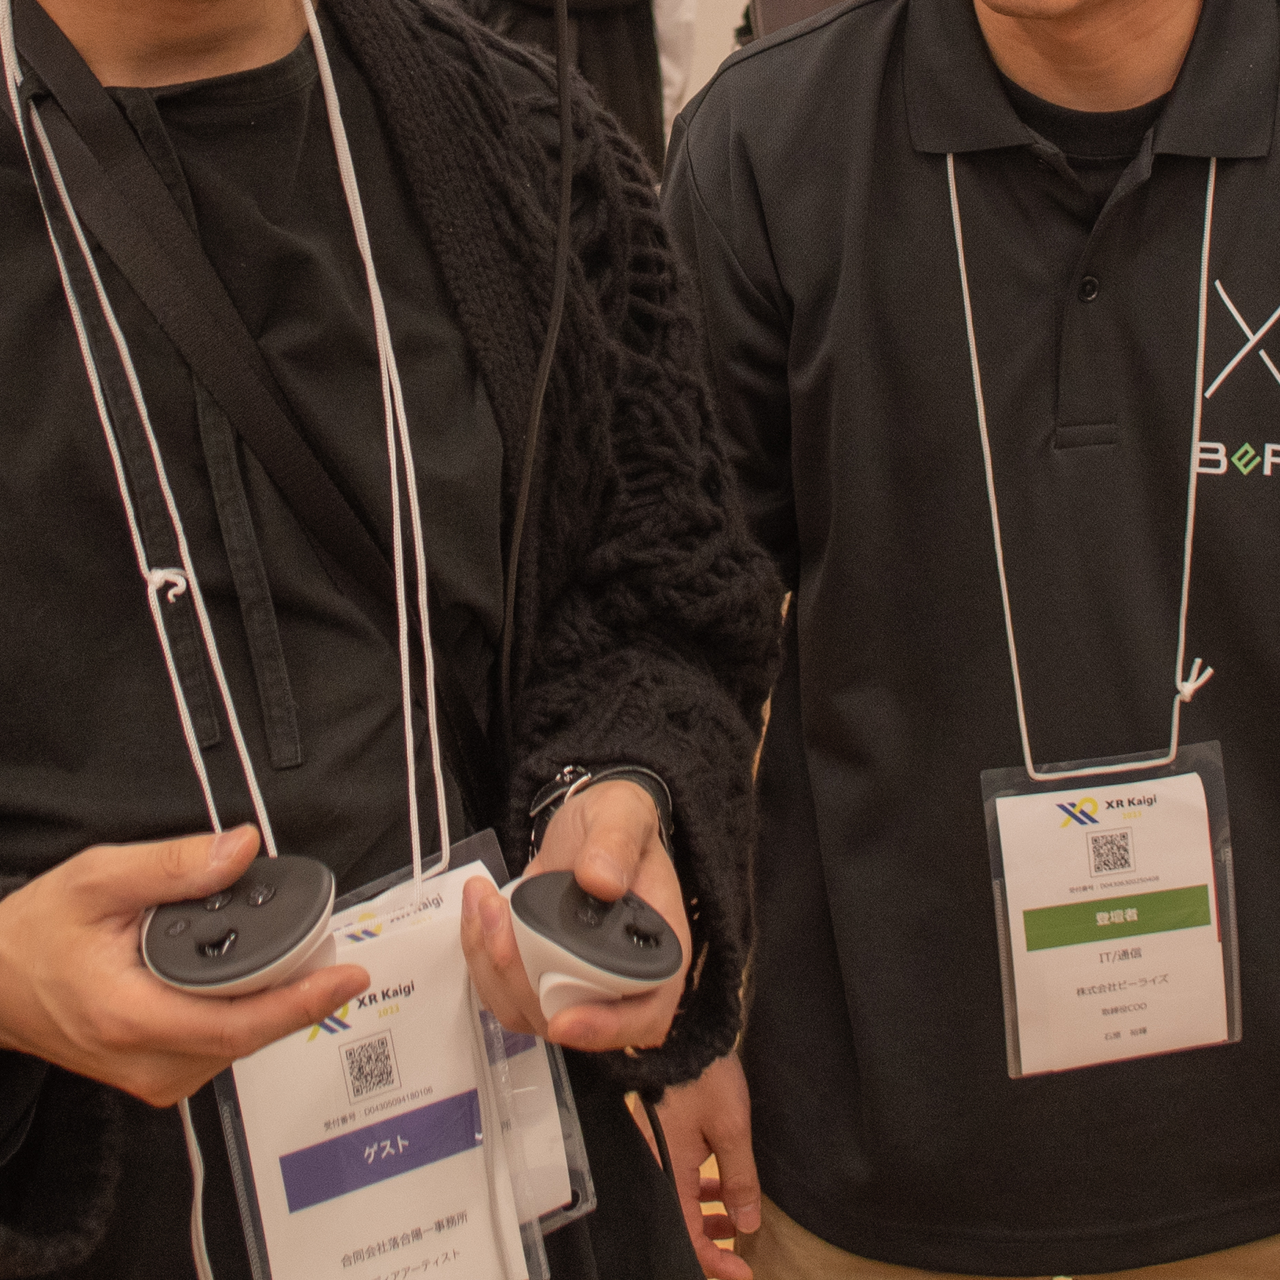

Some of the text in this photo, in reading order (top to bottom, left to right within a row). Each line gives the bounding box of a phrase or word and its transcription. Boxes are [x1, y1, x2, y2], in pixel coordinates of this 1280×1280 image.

[1105, 794, 1157, 810] XR Kaigi
[1099, 947, 1142, 964] IT/通信
[356, 979, 415, 1010] XR Kaigi
[377, 1003, 400, 1019] 2023
[363, 1135, 409, 1164] ゲスト
